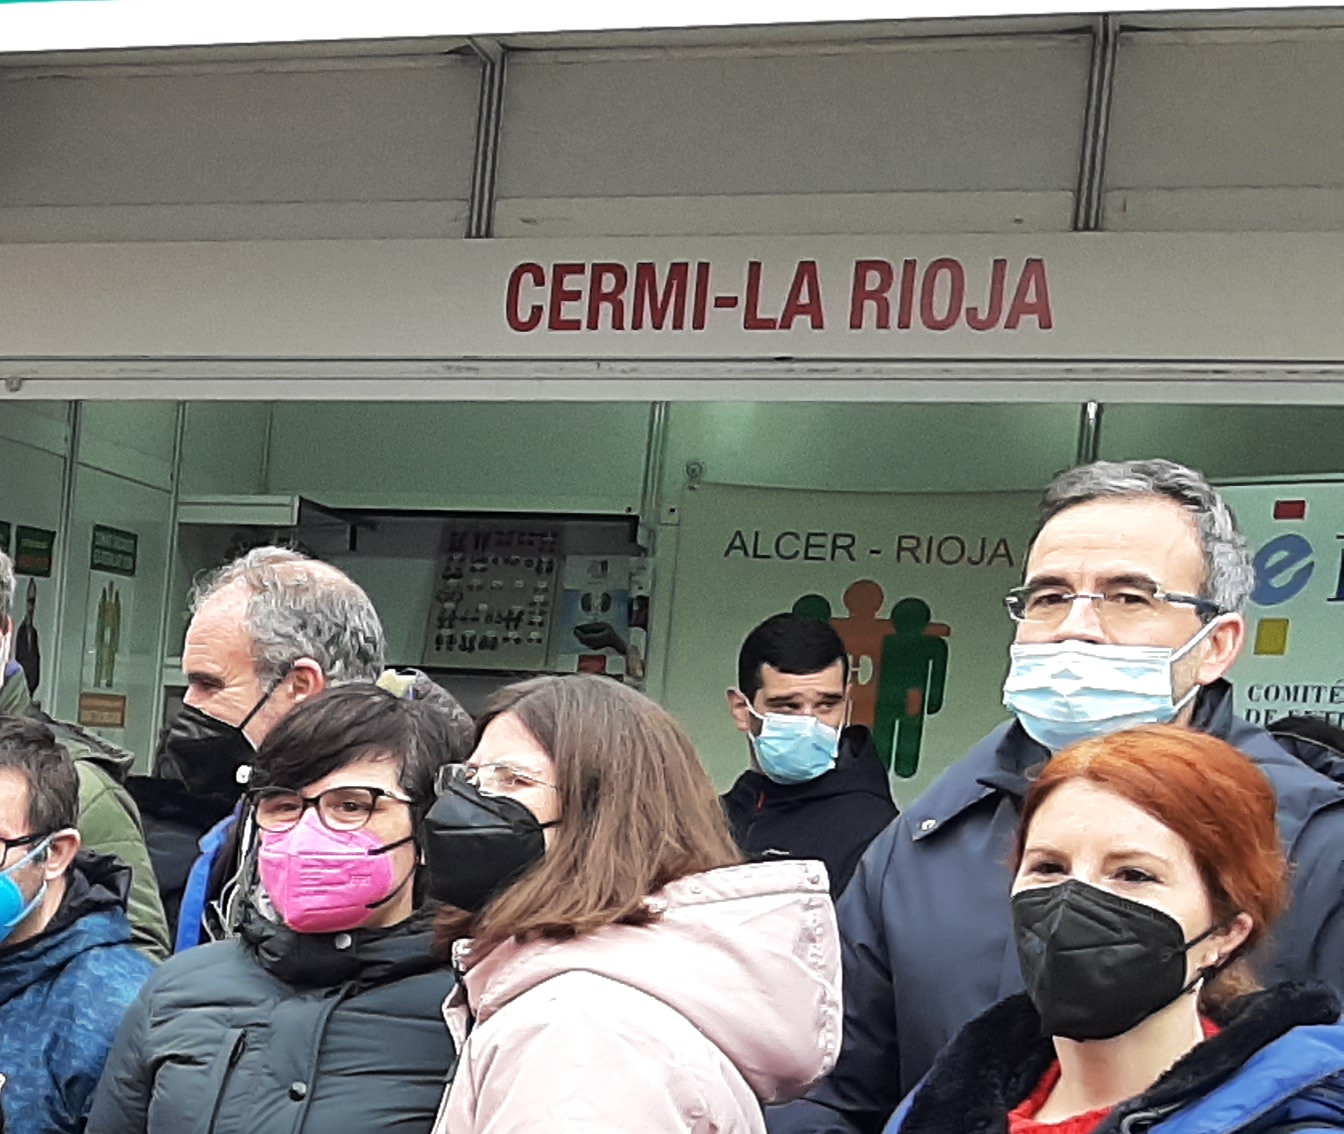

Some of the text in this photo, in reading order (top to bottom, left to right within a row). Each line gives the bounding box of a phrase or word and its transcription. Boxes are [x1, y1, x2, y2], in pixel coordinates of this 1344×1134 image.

[504, 257, 1053, 333] CERMI-LA RIOJA
[723, 530, 857, 562] ALCER
[895, 534, 1015, 568] RIOJA
